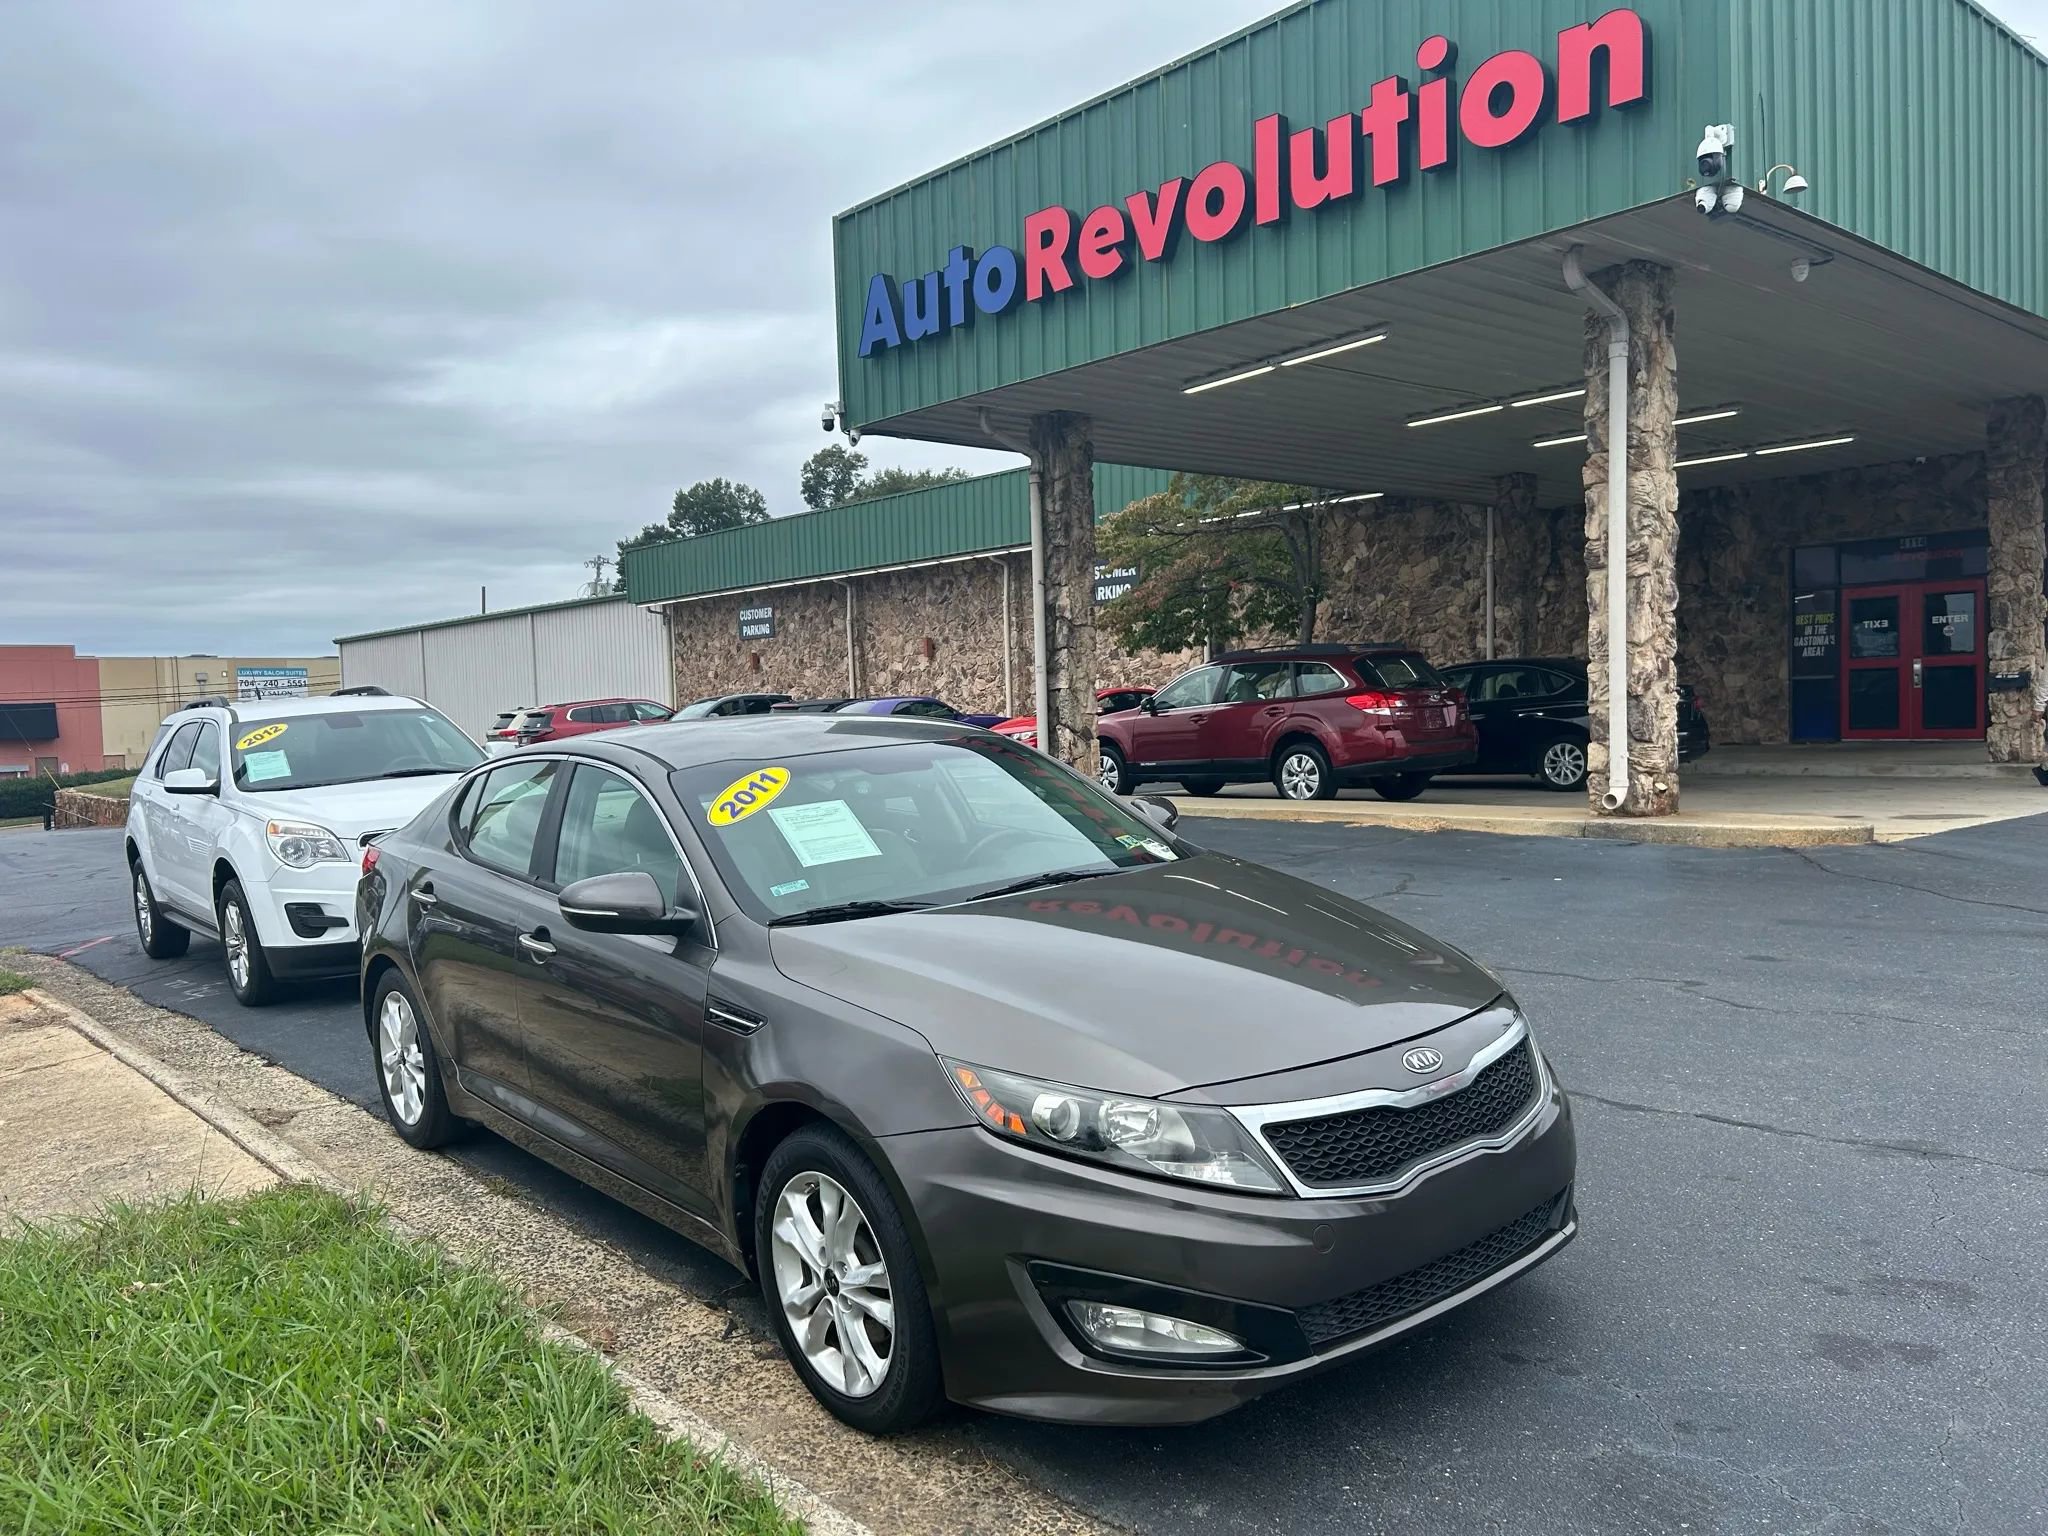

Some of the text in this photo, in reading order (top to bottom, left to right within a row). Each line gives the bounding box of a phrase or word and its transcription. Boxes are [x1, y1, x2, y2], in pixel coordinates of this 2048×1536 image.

[1094, 565, 1137, 580] STMER
[740, 607, 772, 621] CUSTOMER
[1795, 612, 1835, 625] BEST PRICE
[1931, 614, 1969, 625] ENTER
[742, 623, 770, 636] PARKING
[1804, 624, 1828, 635] IN THE
[1802, 646, 1825, 657] AREA!
[243, 725, 282, 746] 2012
[719, 772, 780, 819] 2011
[1407, 1050, 1440, 1069] KIA
